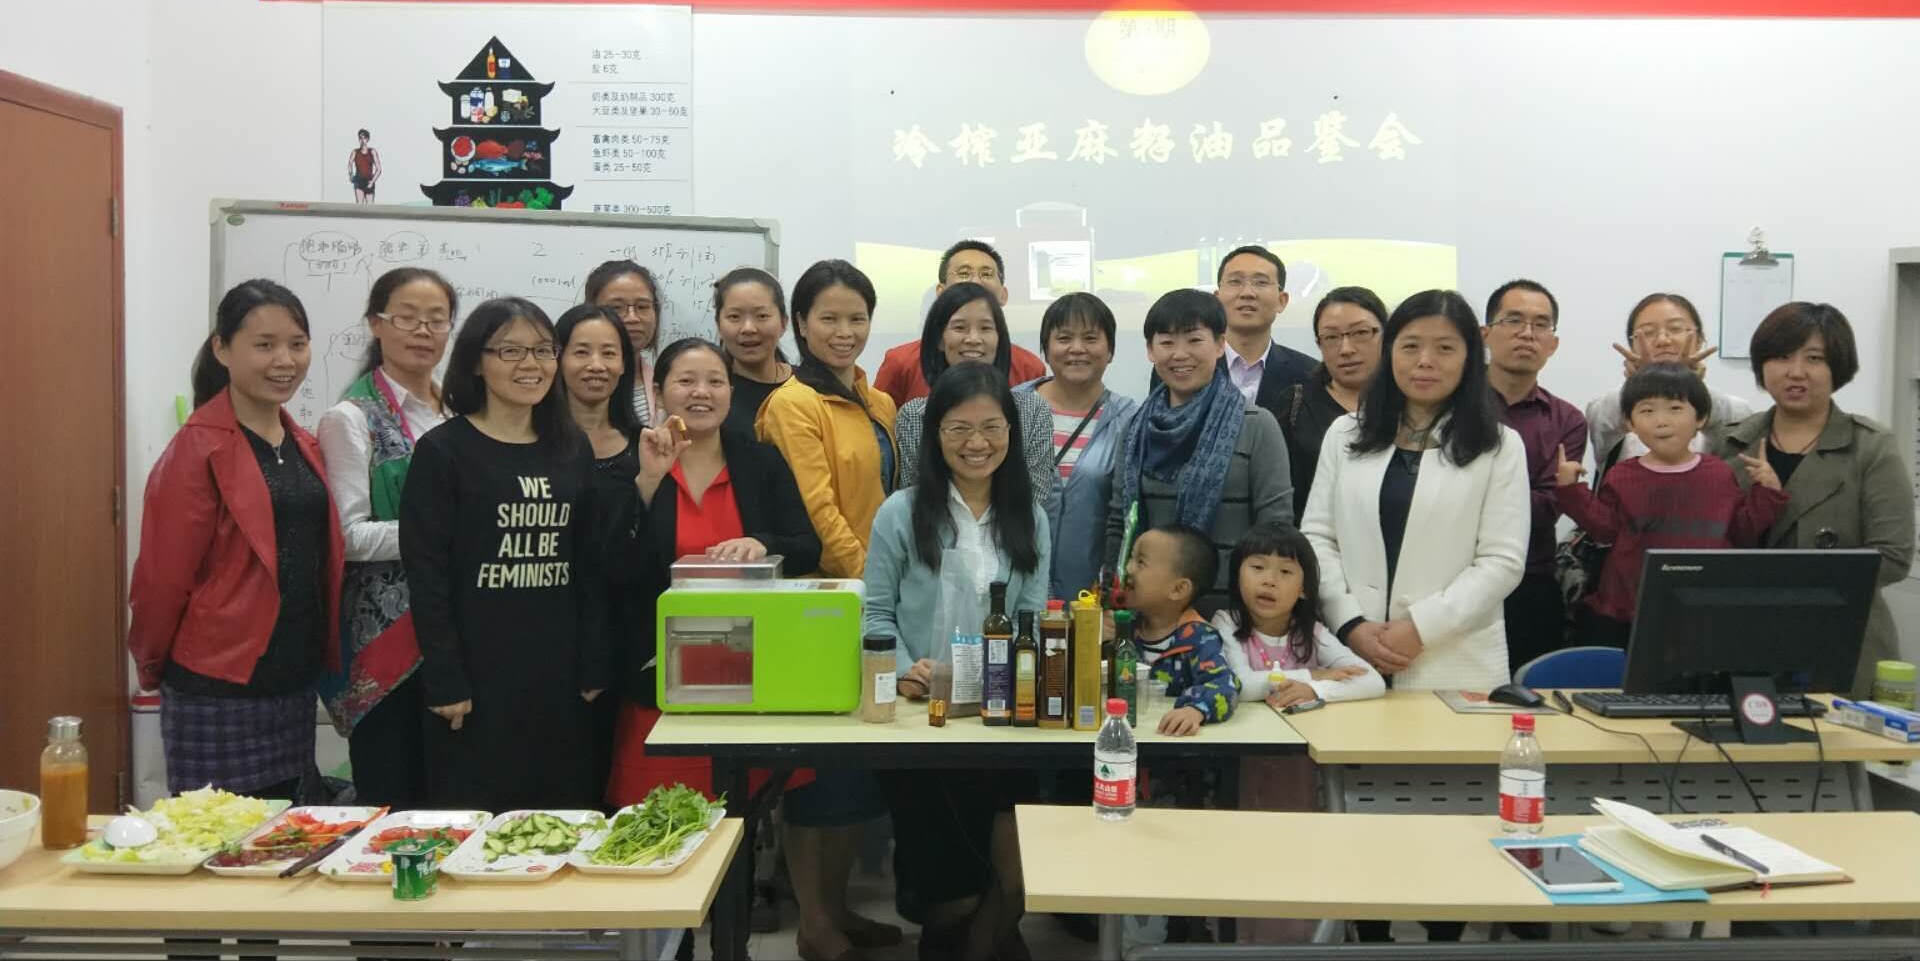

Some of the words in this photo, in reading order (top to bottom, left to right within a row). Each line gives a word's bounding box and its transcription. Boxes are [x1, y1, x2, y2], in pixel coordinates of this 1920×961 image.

[892, 110, 1424, 168] 冷榨亚麻籽油品鉴会
[517, 476, 552, 499] WE
[496, 502, 571, 528] SHOULD
[497, 532, 535, 558] ALL
[538, 532, 560, 557] BE
[476, 561, 570, 588] FEMINISTS
